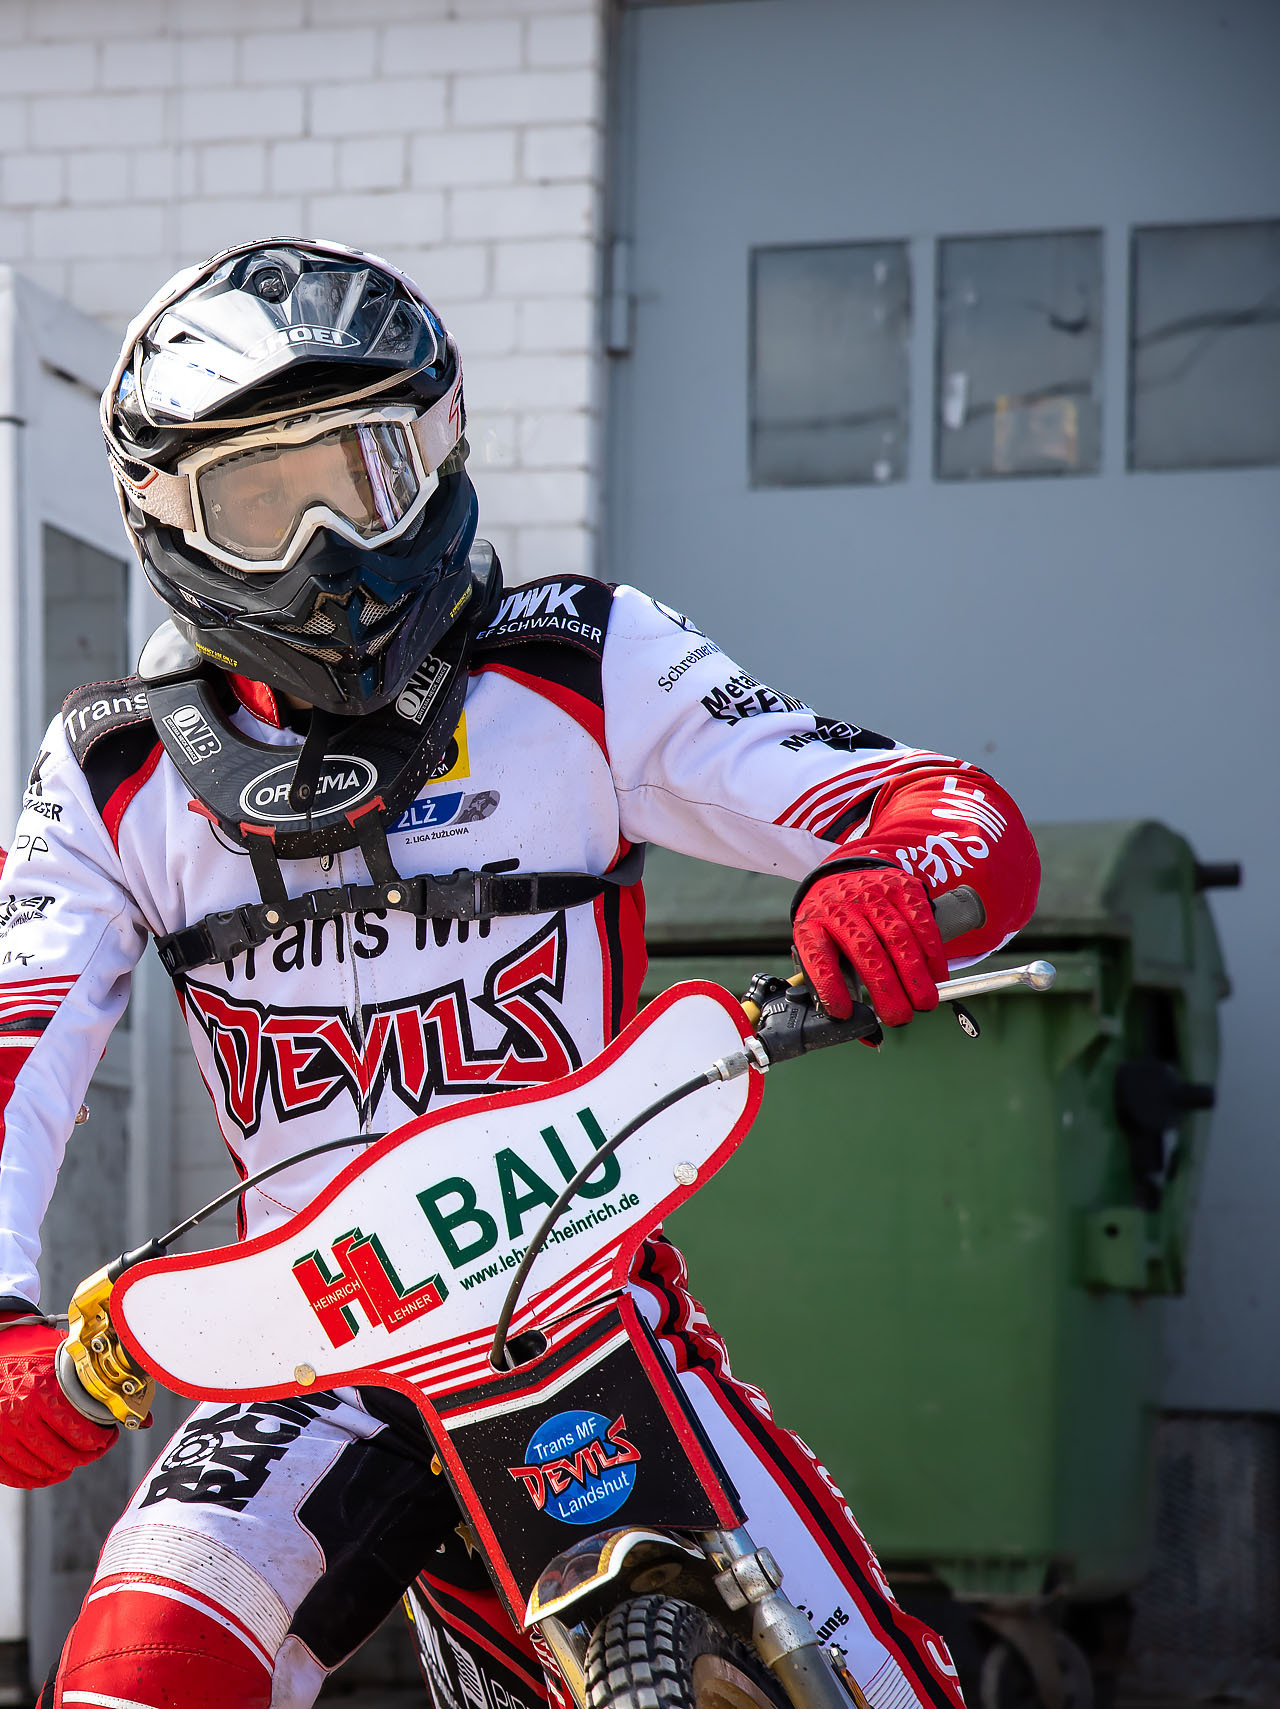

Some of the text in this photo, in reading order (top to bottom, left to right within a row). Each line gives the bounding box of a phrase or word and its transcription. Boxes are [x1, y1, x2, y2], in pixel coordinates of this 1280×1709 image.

[496, 616, 602, 643] SCHWAIGER
[395, 653, 441, 719] ONB
[64, 691, 149, 743] Trans
[171, 703, 222, 759] ONB
[255, 769, 360, 806] OREMA
[413, 832, 430, 843] LIGA
[185, 910, 583, 1140] DEVILS
[416, 1107, 622, 1271] BAU
[312, 1278, 361, 1312] HEINRICH
[386, 1293, 433, 1324] LEHNER
[507, 1414, 642, 1511] DEVILS
[533, 1416, 598, 1461] Trans MF
[558, 1470, 630, 1518] Landshut
